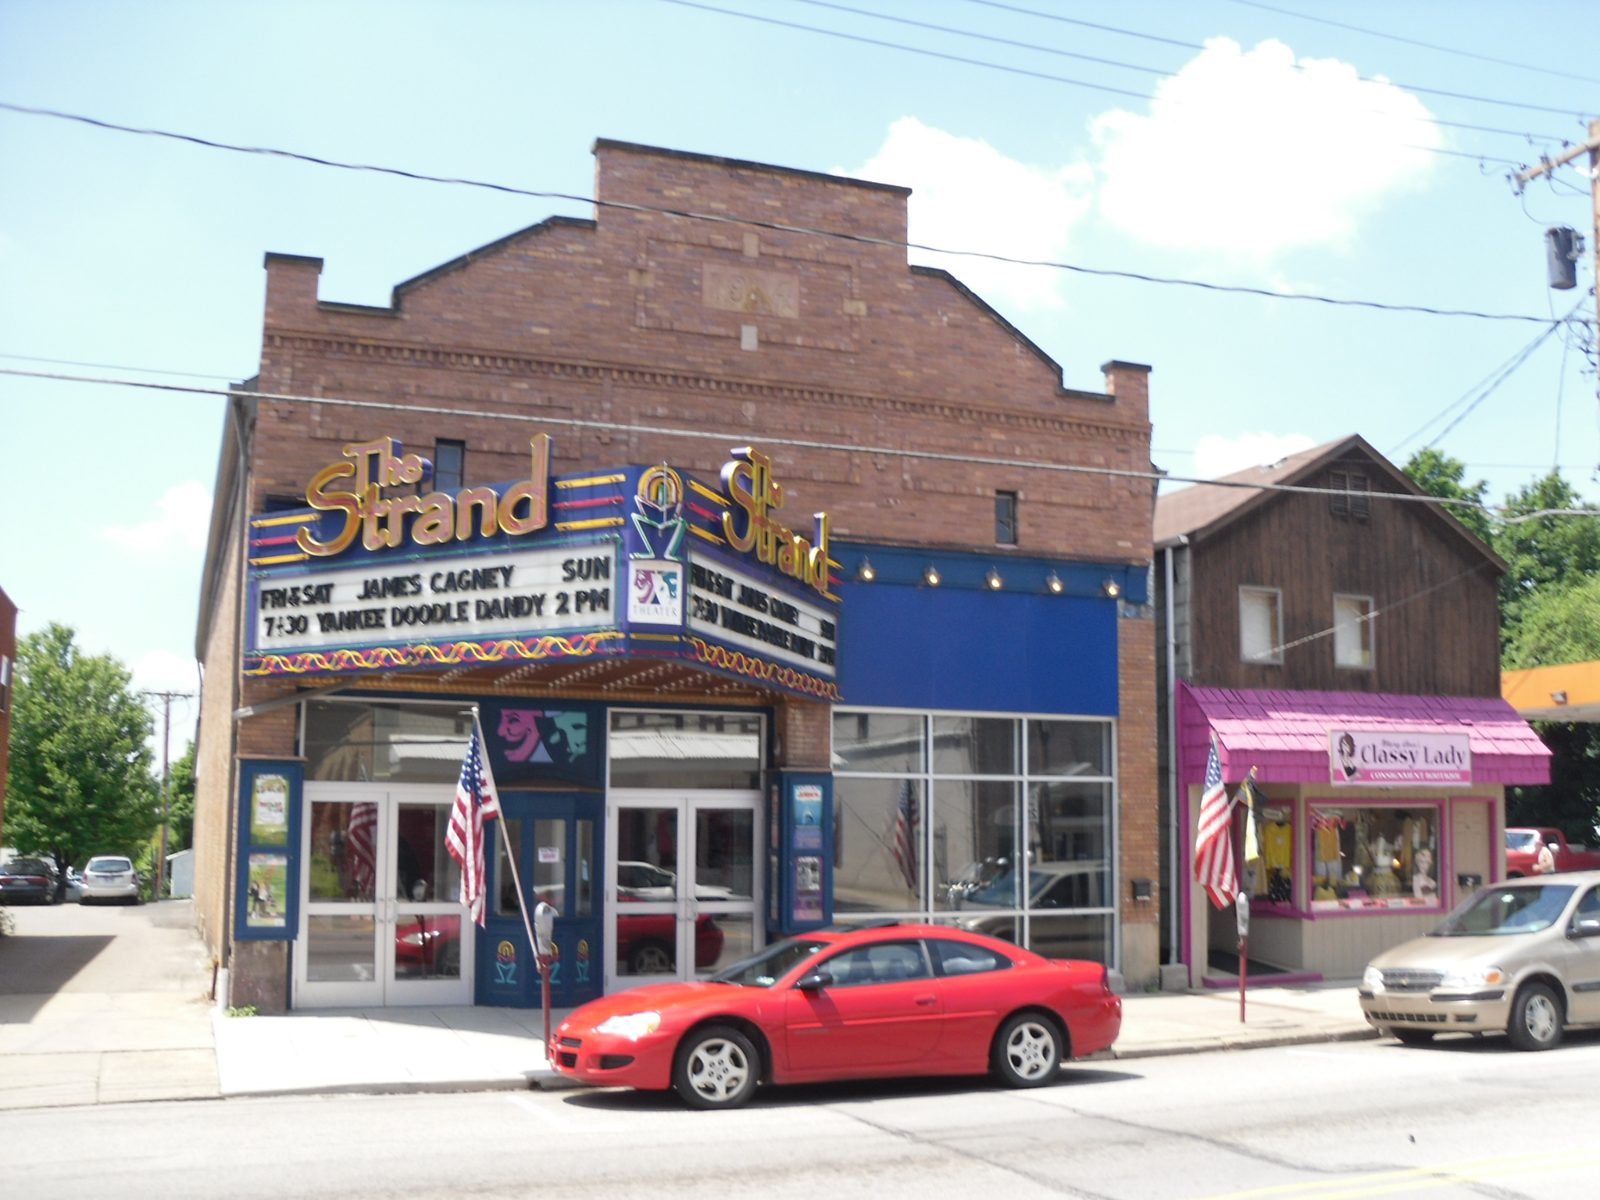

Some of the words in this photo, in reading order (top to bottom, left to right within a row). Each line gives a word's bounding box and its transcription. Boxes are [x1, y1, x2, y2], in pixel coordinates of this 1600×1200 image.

[343, 435, 431, 496] The
[296, 432, 552, 557] Strand
[720, 460, 831, 595] Strand
[357, 574, 422, 600] JAMES
[430, 564, 516, 594] CAGNEY
[562, 556, 610, 583] SUN
[317, 608, 386, 633] YANKEE
[392, 601, 469, 627] DOODLE
[476, 593, 547, 621] DANDY
[555, 592, 570, 615] 2
[575, 588, 610, 613] PM
[633, 604, 678, 618] THEATER
[1361, 744, 1418, 769] Classy
[1424, 745, 1465, 769] Lady
